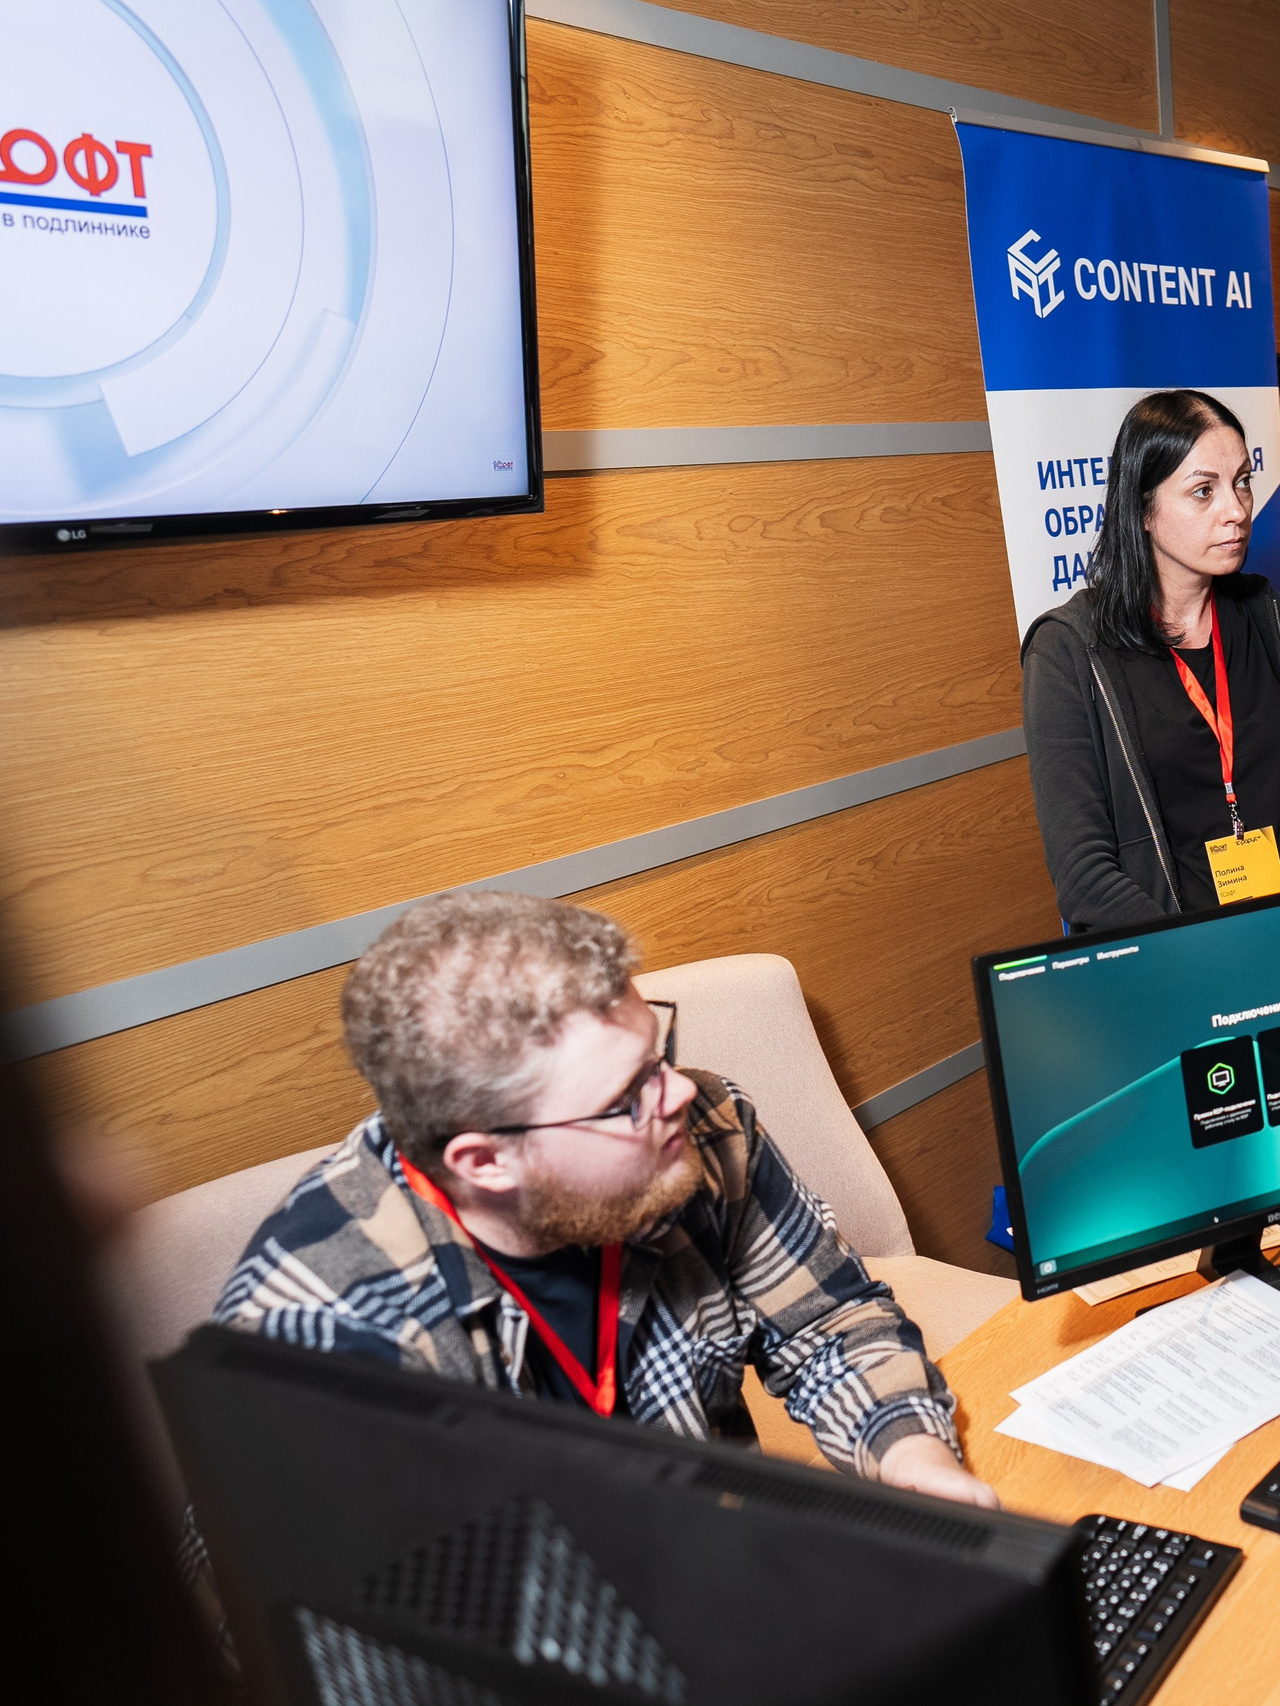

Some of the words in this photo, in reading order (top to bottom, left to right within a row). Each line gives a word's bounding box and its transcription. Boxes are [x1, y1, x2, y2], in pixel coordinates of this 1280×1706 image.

[23, 215, 151, 239] подлиннике
[1074, 257, 1216, 307] CONTENT
[1225, 270, 1252, 309] AI
[71, 529, 87, 540] LG
[1215, 865, 1245, 878] Полина
[1217, 875, 1248, 888] Зимина
